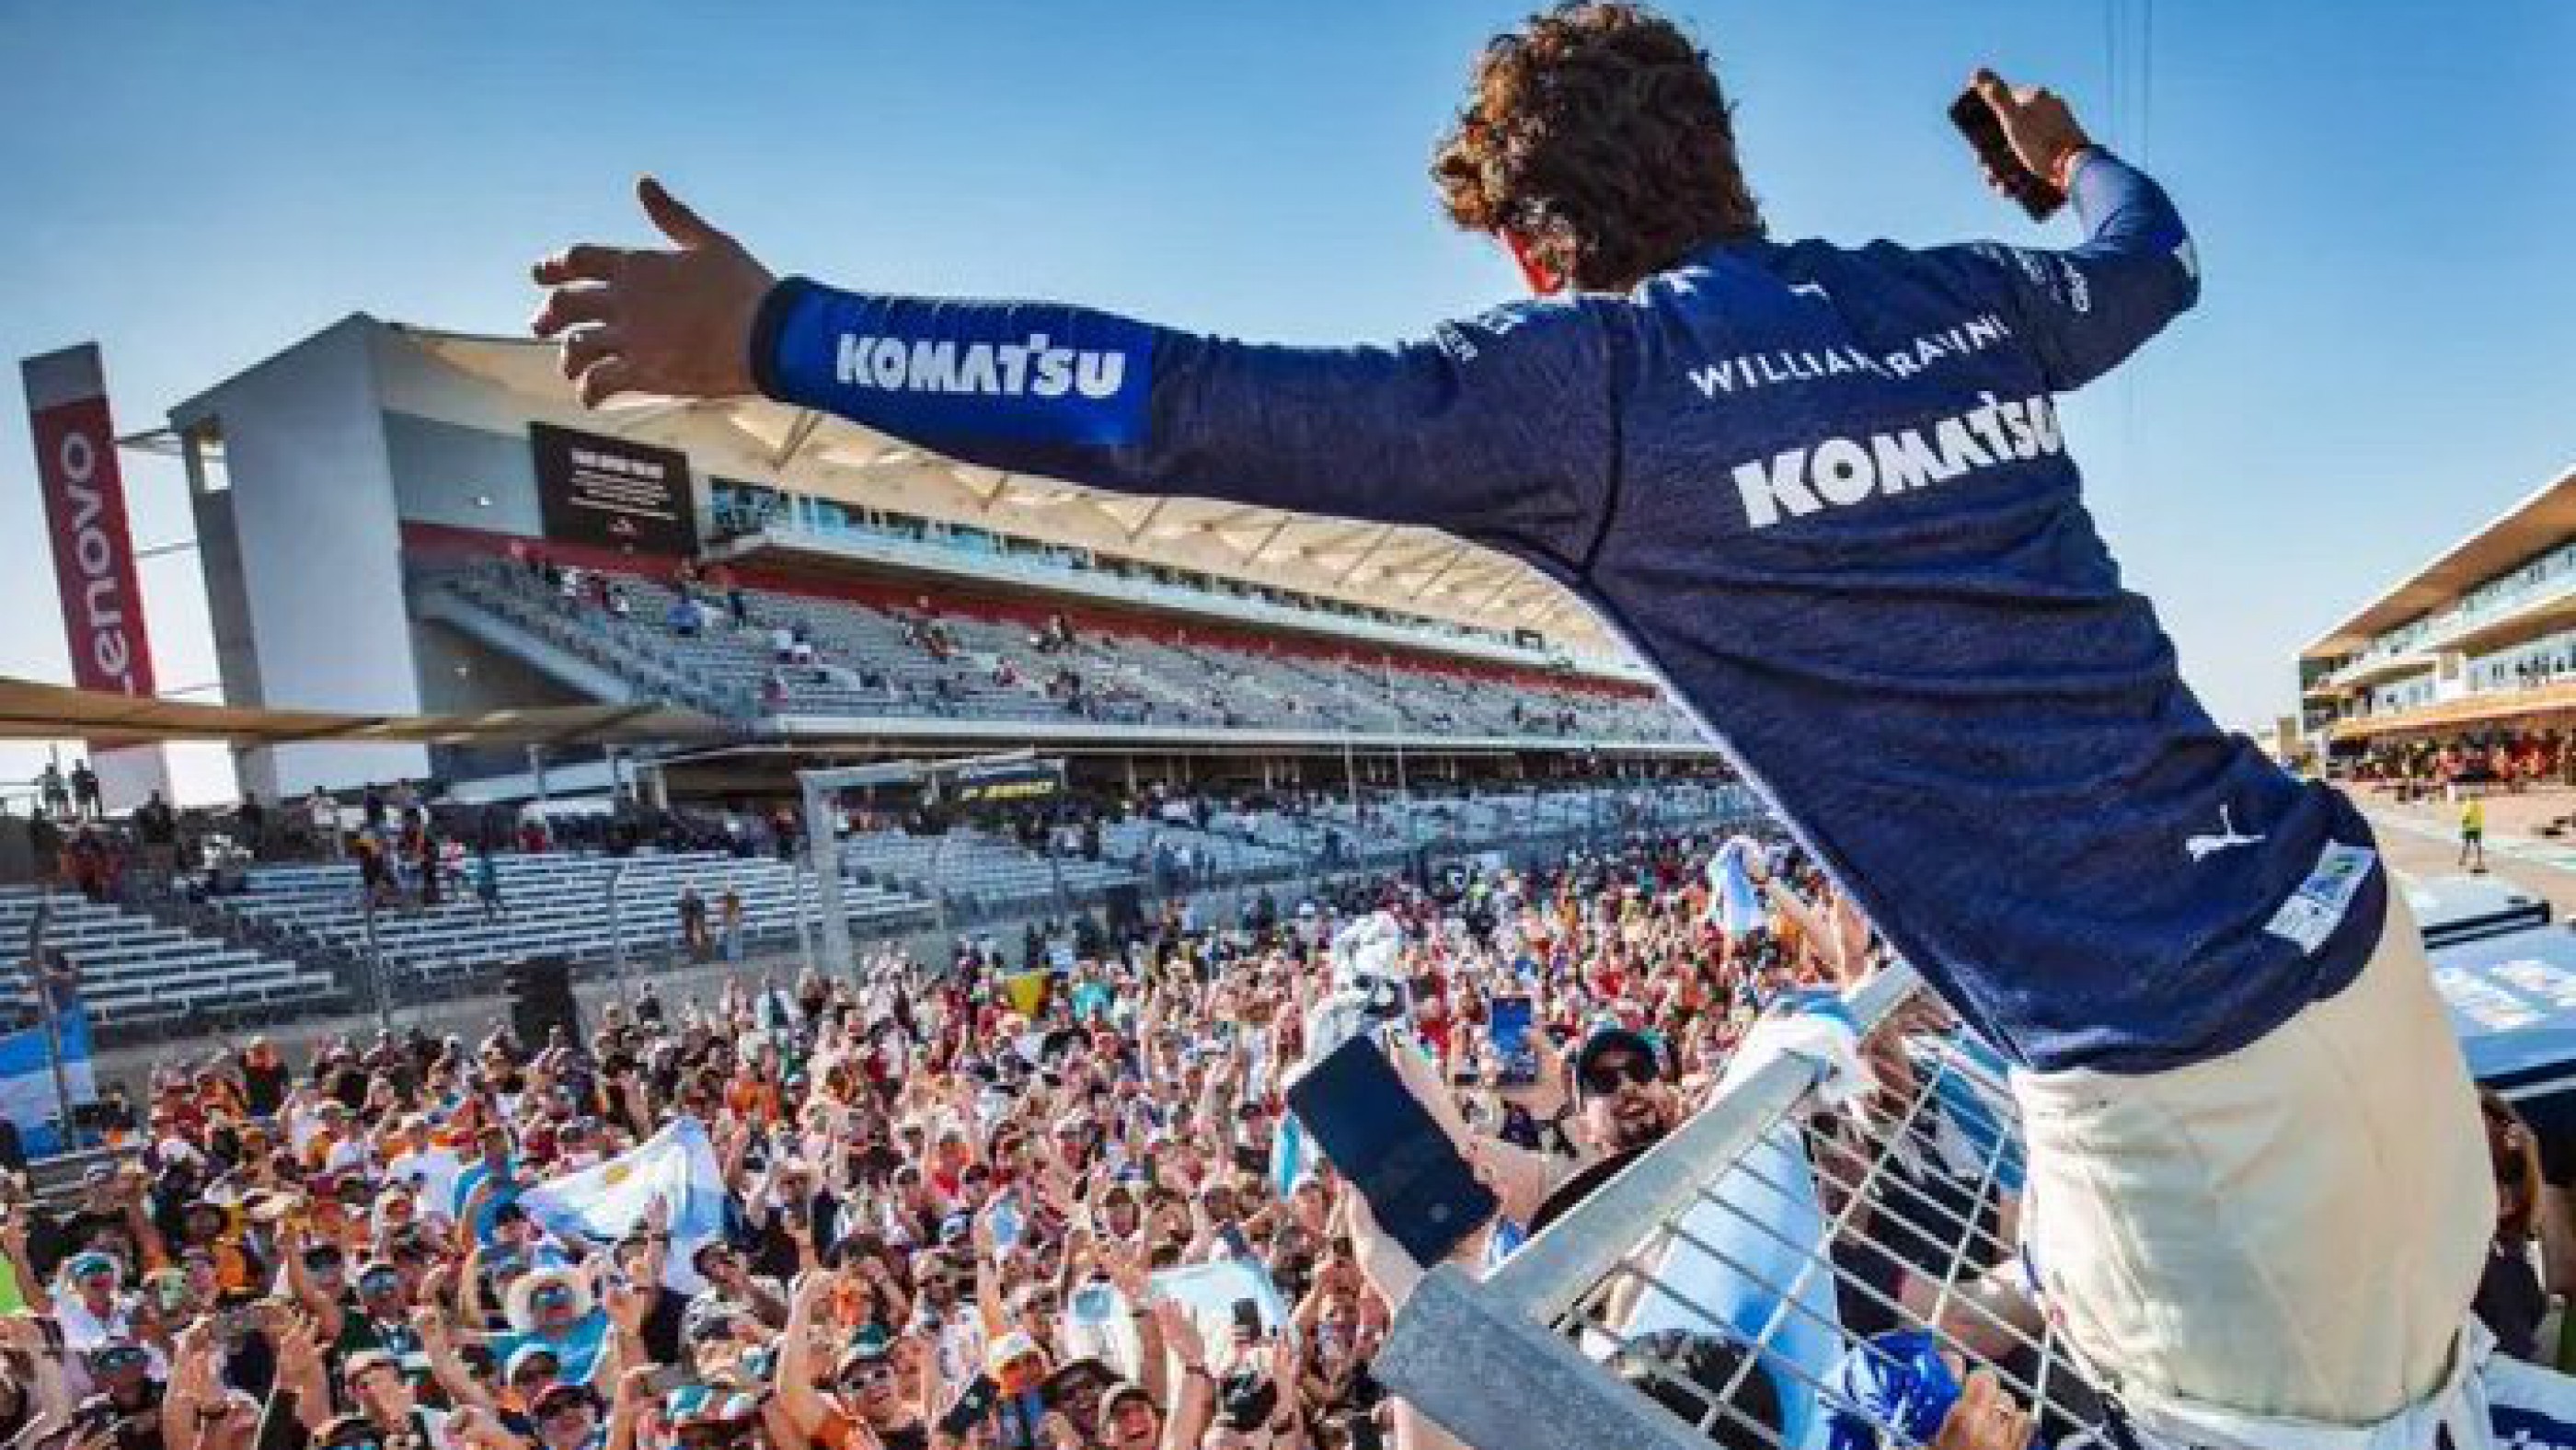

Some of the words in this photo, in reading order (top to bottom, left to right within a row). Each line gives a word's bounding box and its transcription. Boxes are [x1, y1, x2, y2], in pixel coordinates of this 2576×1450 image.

[836, 333, 1126, 397] KOMATSU
[1731, 391, 2064, 528] KOMATSU
[59, 431, 134, 697] enovo
